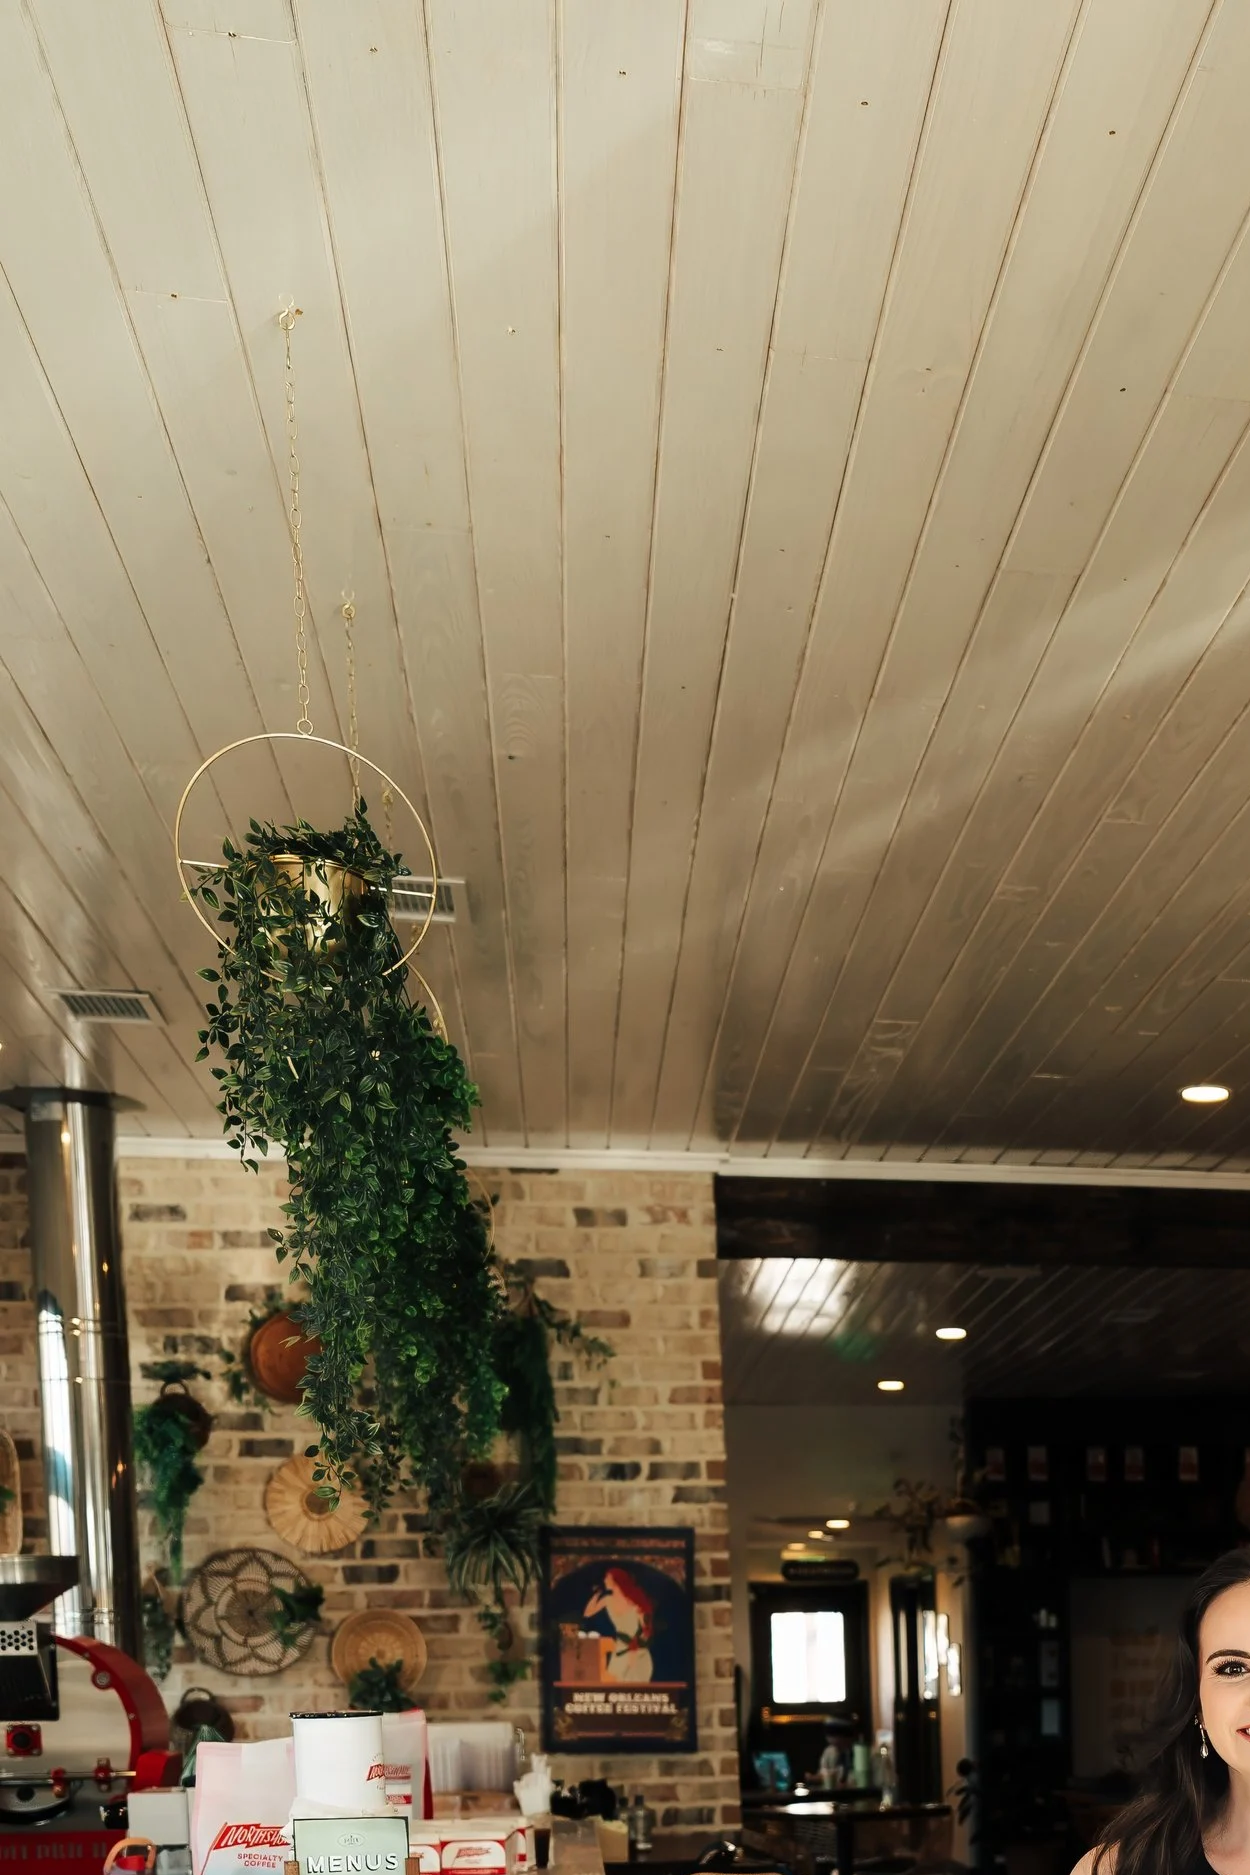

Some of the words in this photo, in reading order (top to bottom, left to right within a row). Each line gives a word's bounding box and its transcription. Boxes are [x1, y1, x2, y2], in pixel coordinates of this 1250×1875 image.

[572, 1691, 606, 1703] NEW
[608, 1691, 670, 1703] ORLEANS
[616, 1702, 679, 1715] FESTIVAL
[237, 1852, 284, 1862] SPECIALTY
[306, 1852, 400, 1874] MENUS
[243, 1860, 277, 1869] COFFEE
